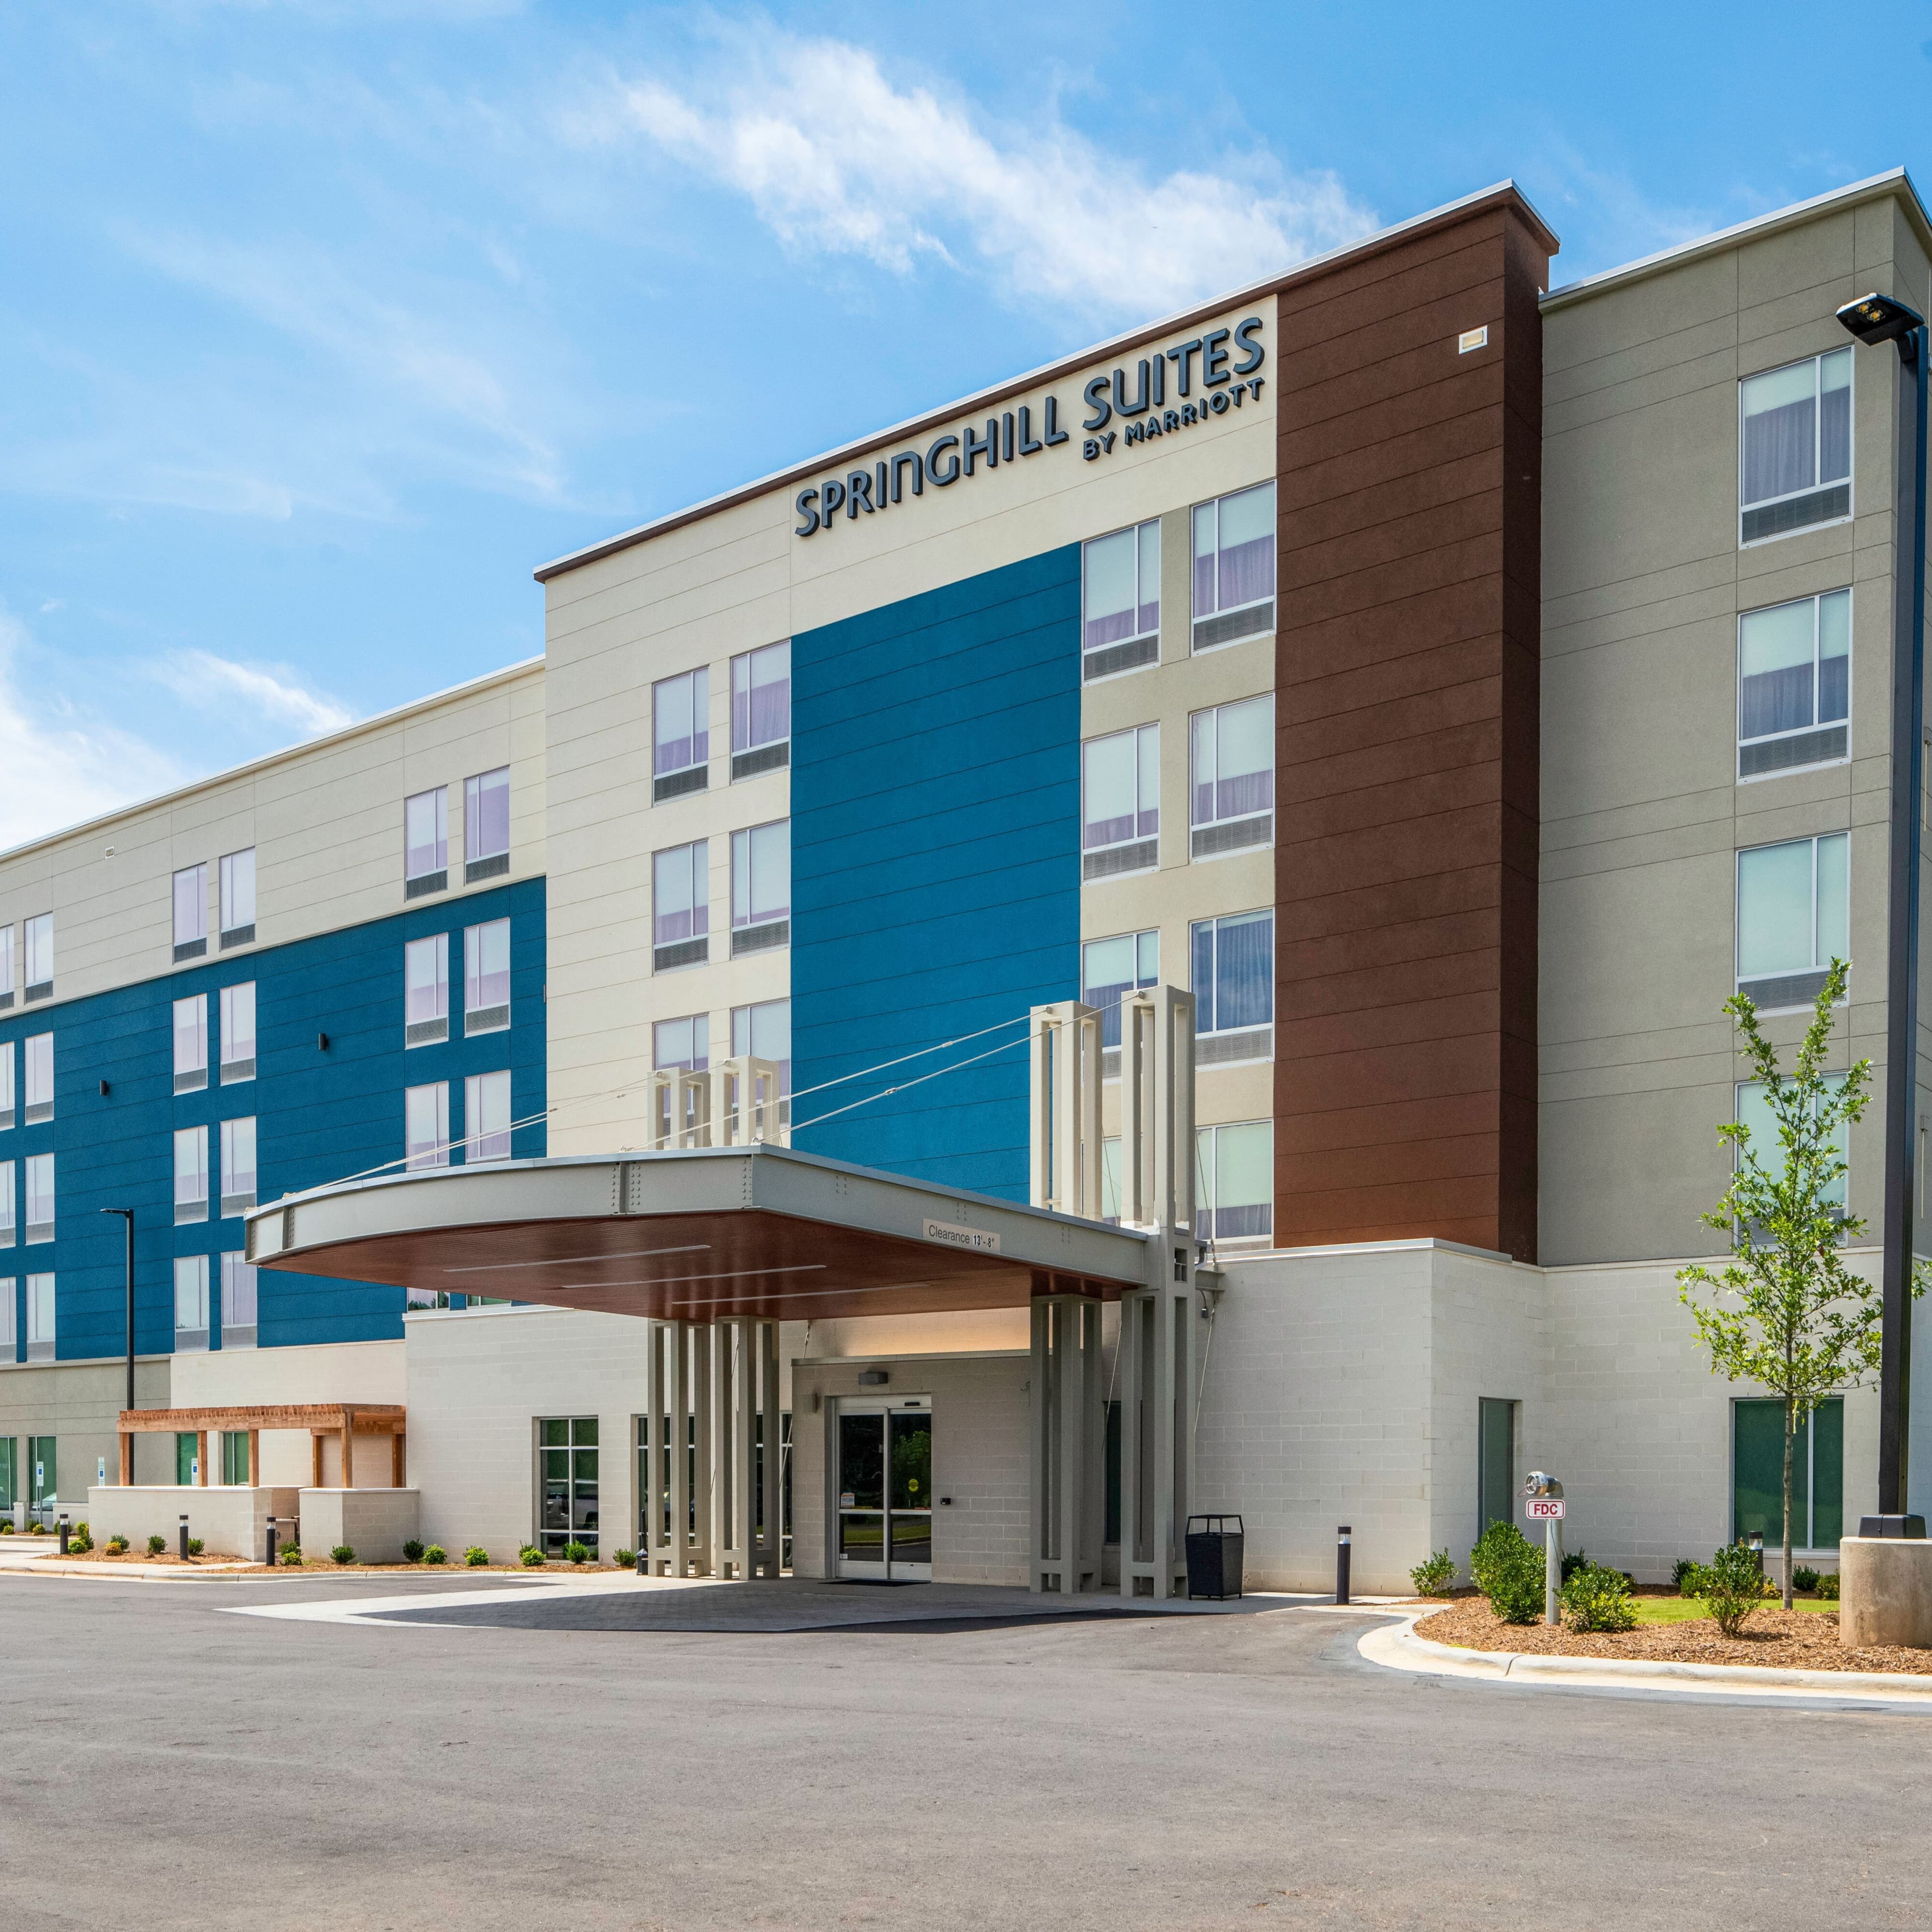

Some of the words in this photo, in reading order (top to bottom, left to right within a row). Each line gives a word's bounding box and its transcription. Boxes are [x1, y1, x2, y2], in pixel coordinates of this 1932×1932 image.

[795, 396, 1069, 536] SPRINGHILL
[1082, 317, 1265, 431] SUITES
[1083, 431, 1116, 461] BY
[1124, 377, 1265, 447] MARRIOTT
[929, 1225, 970, 1244] Clearance
[1534, 1504, 1558, 1515] FDC
